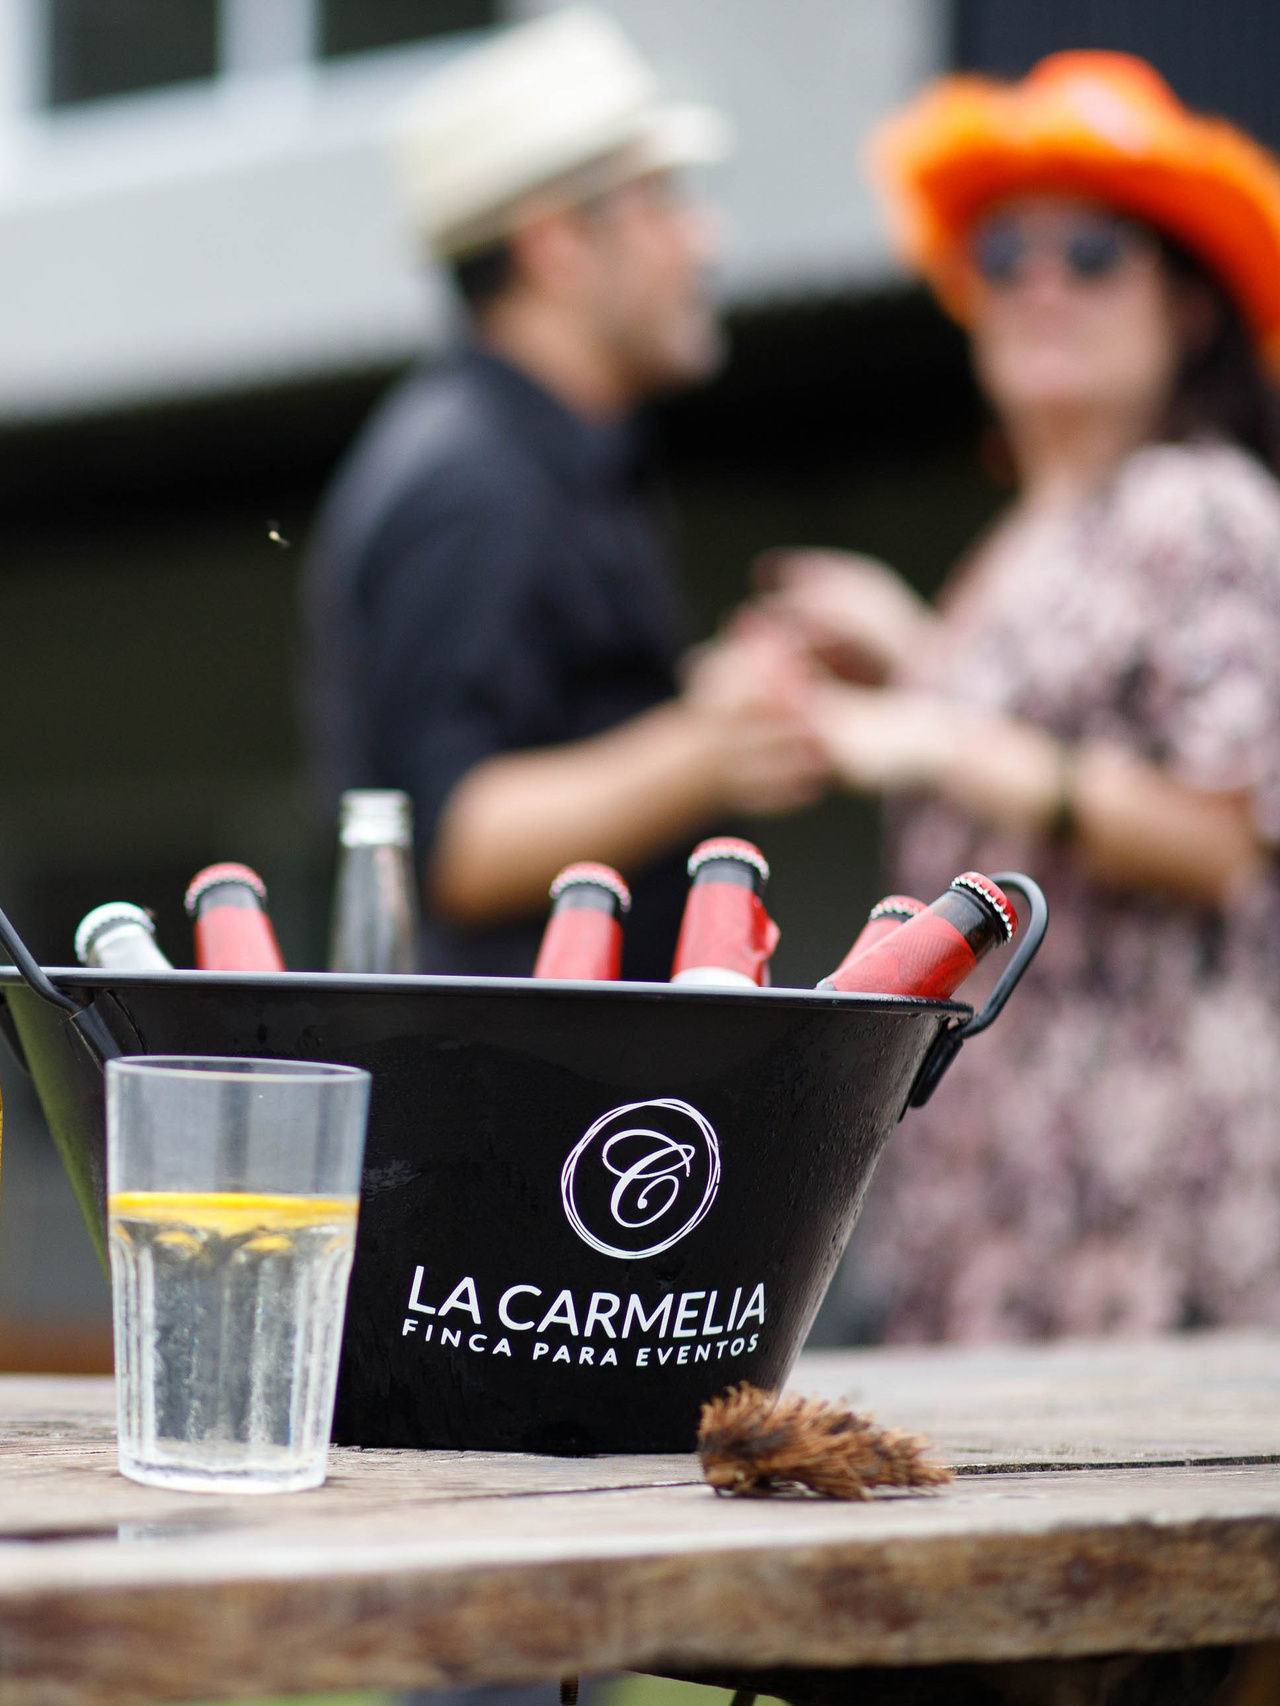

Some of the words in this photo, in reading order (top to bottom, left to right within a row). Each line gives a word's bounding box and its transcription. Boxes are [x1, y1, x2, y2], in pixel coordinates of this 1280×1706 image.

[408, 1265, 482, 1325] LA
[498, 1282, 766, 1340] CARMELIA
[402, 1318, 512, 1357] FINCA
[532, 1342, 618, 1367] PARA
[635, 1333, 760, 1367] EVENTOS
